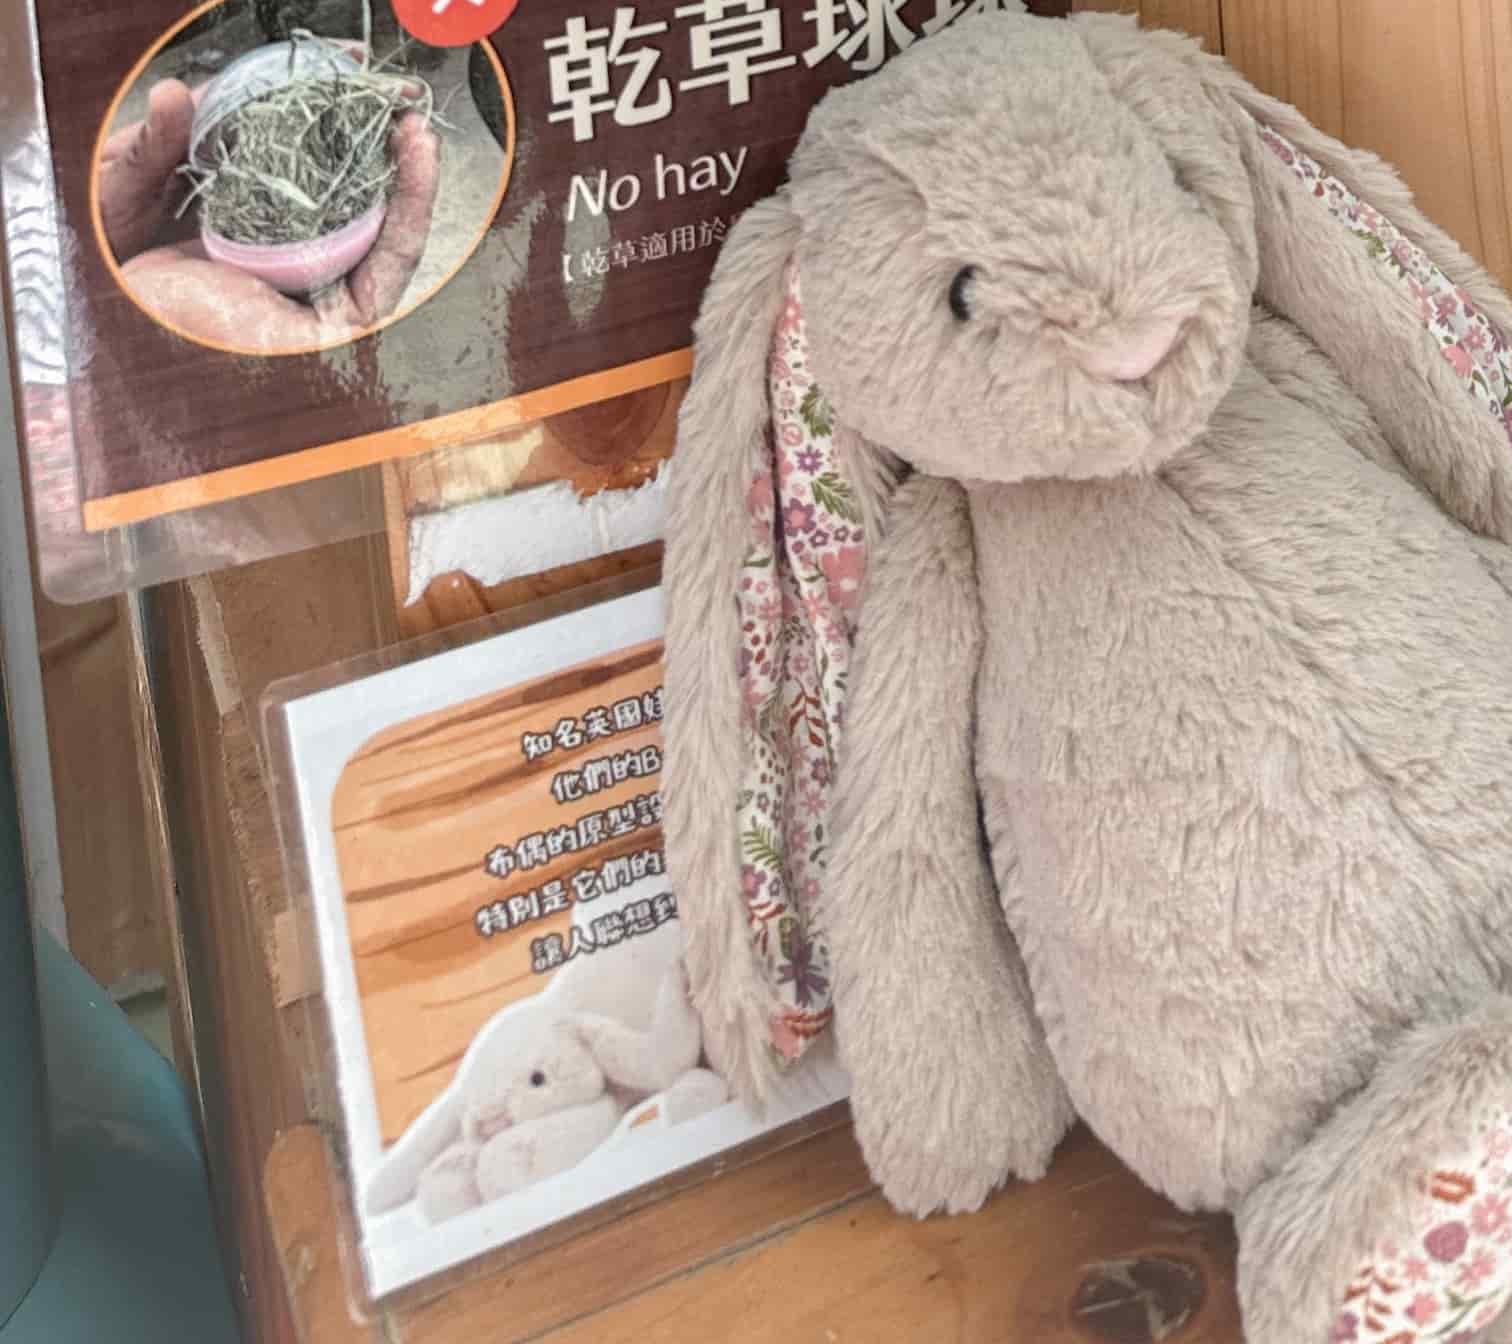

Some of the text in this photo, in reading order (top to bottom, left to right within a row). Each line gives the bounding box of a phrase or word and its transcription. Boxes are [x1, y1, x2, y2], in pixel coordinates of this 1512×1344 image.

[567, 145, 749, 223] No hay
[562, 215, 738, 283] 【乾草適用於
